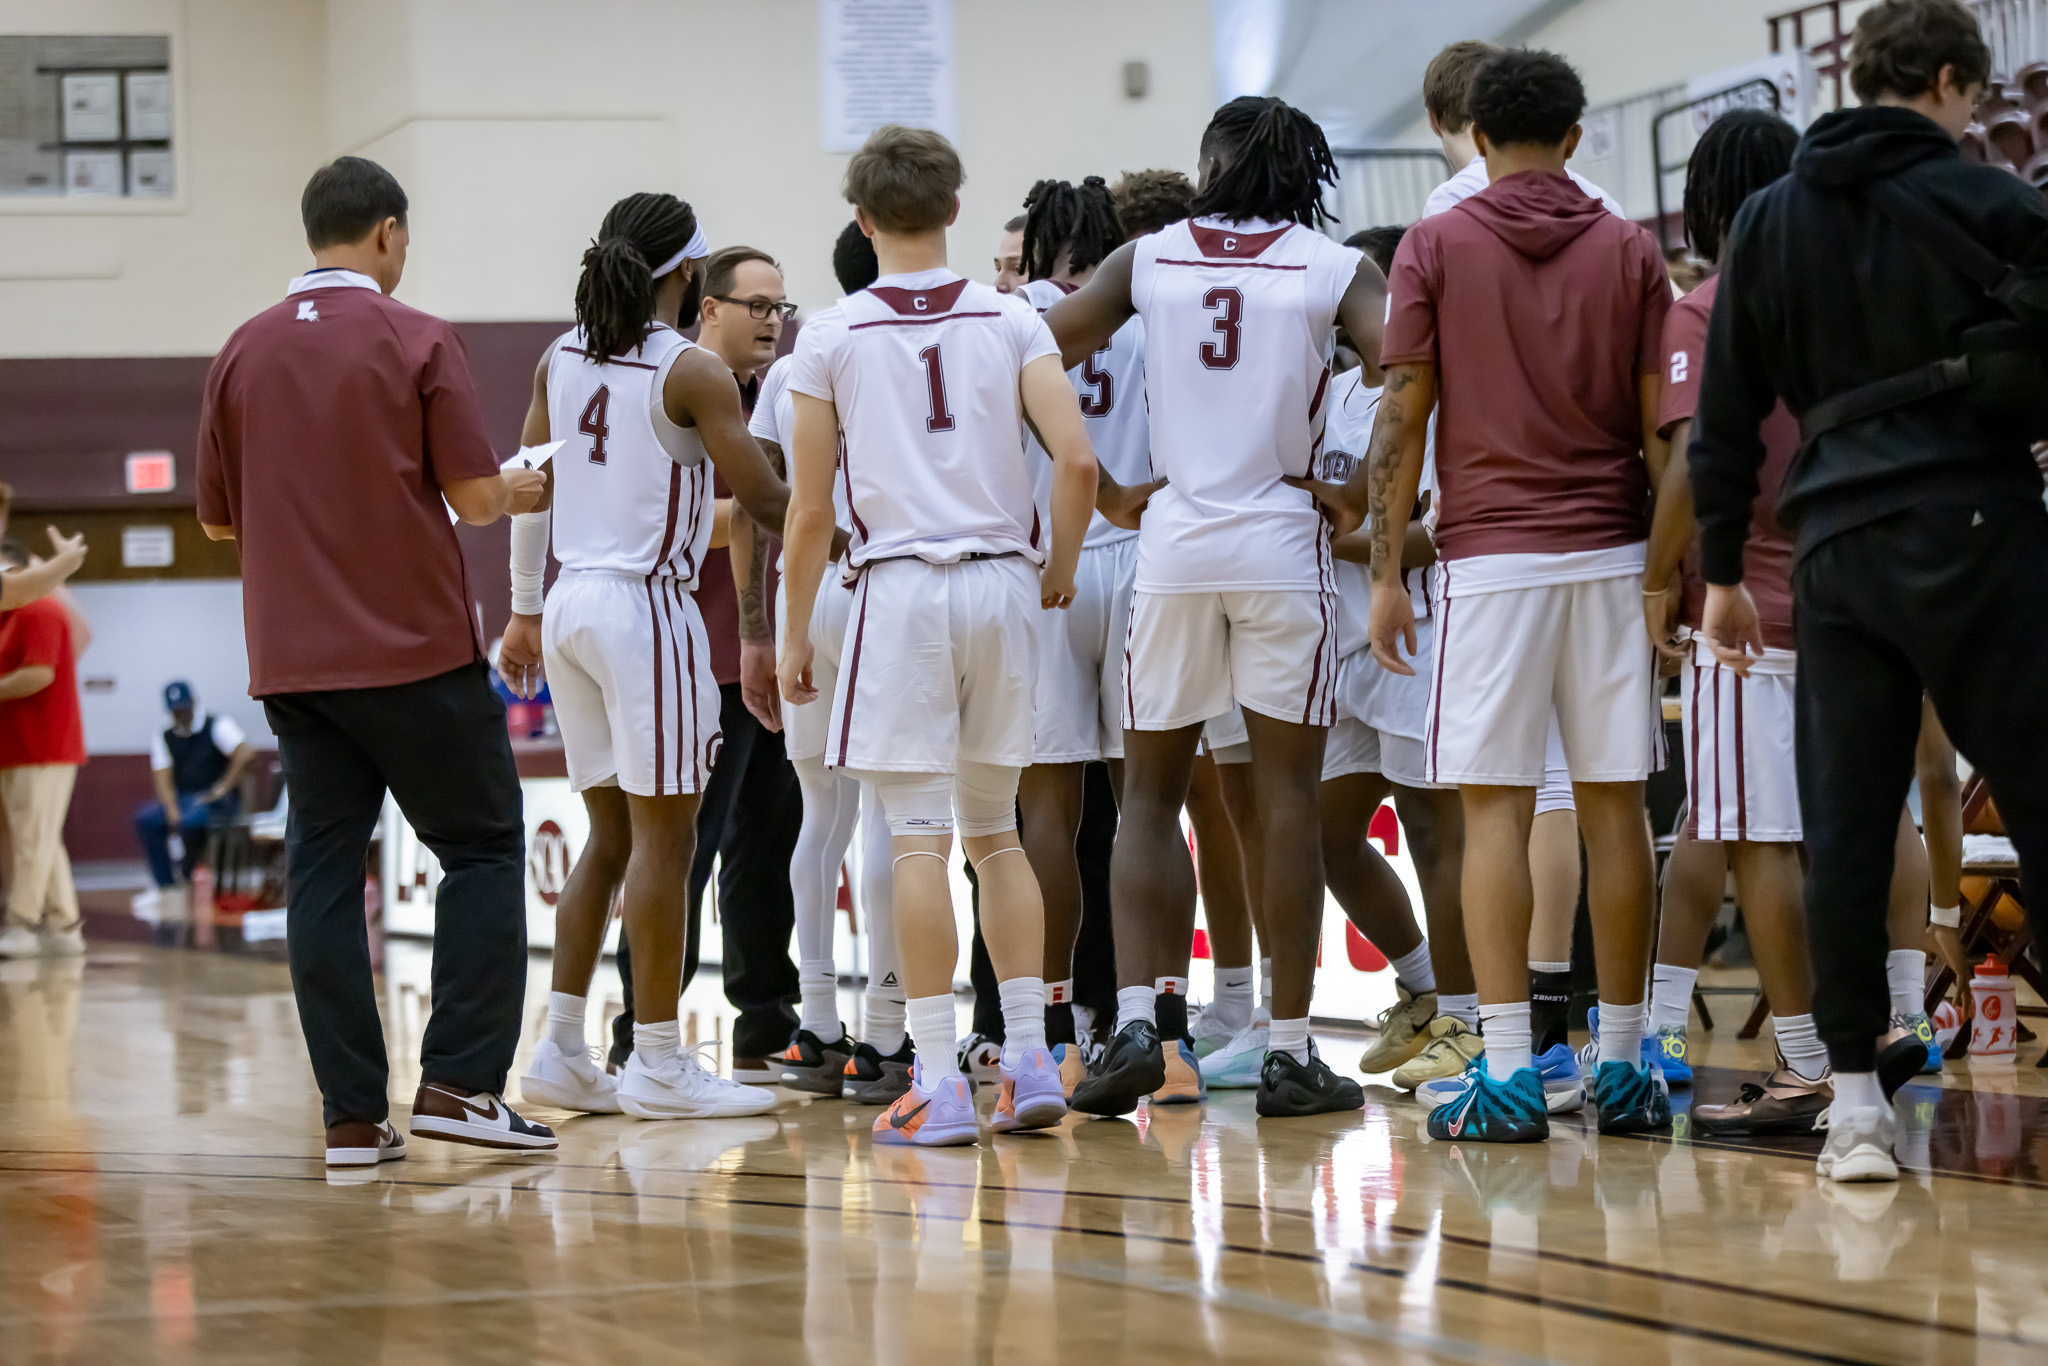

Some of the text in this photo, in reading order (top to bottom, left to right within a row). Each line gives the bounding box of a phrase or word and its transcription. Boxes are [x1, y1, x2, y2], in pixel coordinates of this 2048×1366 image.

[1223, 238, 1237, 251] C
[913, 297, 928, 311] C
[1199, 286, 1244, 370] 3
[919, 343, 955, 433] 1
[1079, 335, 1114, 418] 5
[1670, 350, 1688, 385] 2
[578, 383, 611, 466] 4
